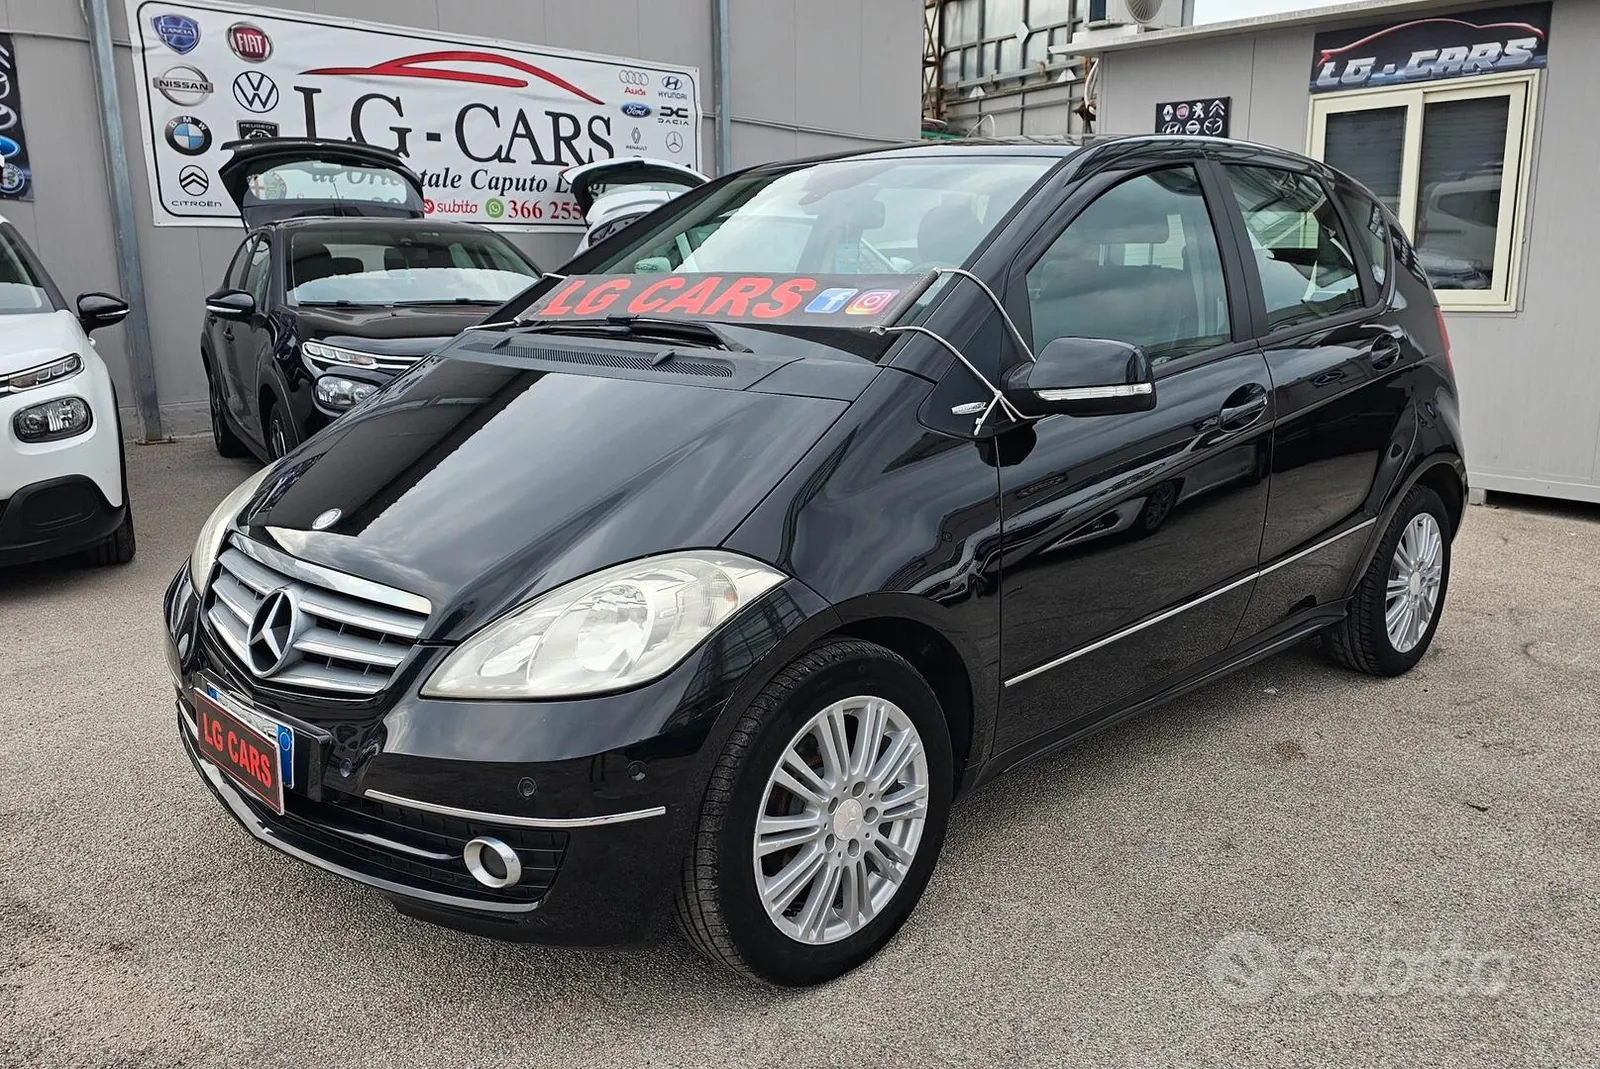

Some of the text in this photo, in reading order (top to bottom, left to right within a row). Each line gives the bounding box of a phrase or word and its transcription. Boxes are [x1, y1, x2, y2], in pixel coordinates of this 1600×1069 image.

[162, 27, 193, 35] LANCIA
[236, 33, 262, 53] FIAT
[159, 80, 209, 91] NISSAN
[624, 87, 646, 96] Audi
[658, 91, 687, 100] HYUNDAI
[626, 104, 648, 117] Ford
[168, 116, 207, 131] BMW
[658, 118, 689, 126] DACIA
[455, 103, 614, 167] CARS
[470, 169, 548, 197] Caputo
[437, 199, 479, 214] subito
[508, 200, 543, 219] 366
[539, 277, 817, 318] LG CARS
[203, 712, 224, 752] LG
[227, 731, 272, 788] CARS
